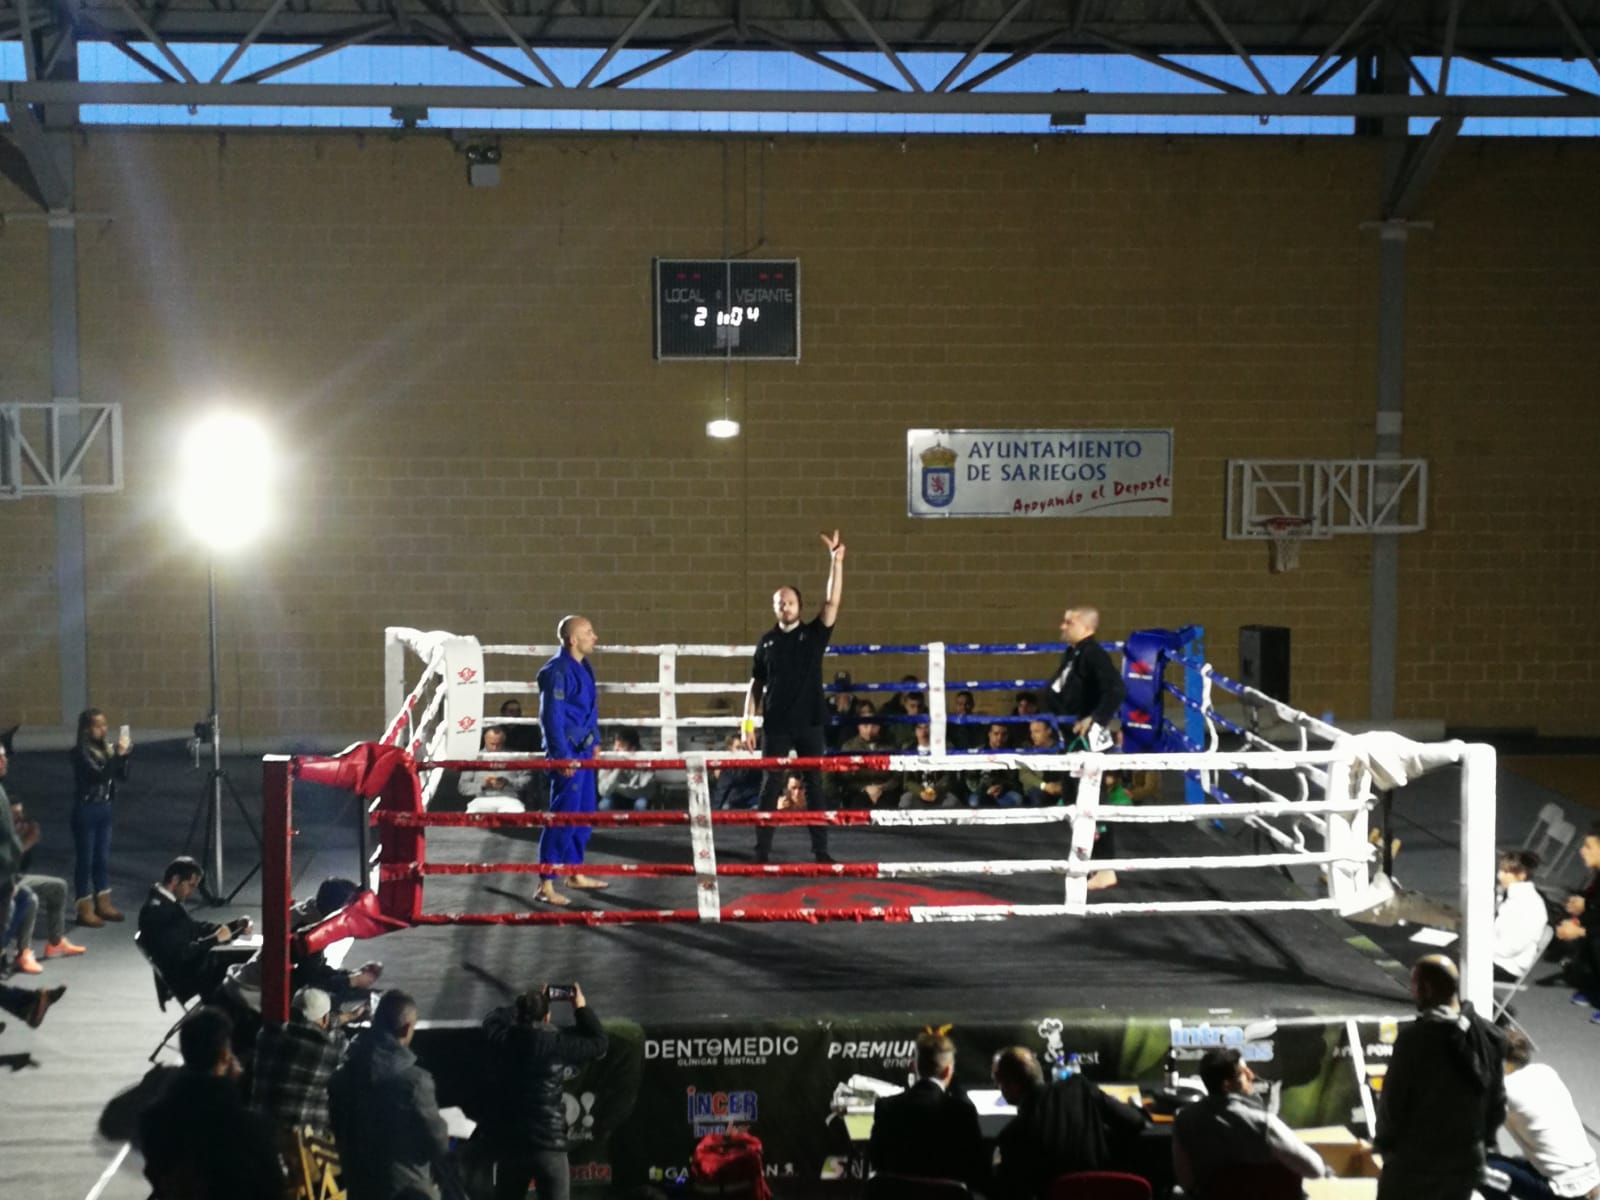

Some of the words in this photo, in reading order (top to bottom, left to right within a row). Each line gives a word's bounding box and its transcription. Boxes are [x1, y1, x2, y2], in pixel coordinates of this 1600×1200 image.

[665, 288, 705, 303] LOCAL
[736, 288, 793, 303] VISITANTE
[968, 440, 1142, 459] AYUNTAMIENTO
[967, 464, 990, 481] DE
[1001, 463, 1107, 481] SARIEGOS
[1012, 489, 1083, 514] Apoyando
[1092, 484, 1106, 500] el
[1114, 474, 1171, 497] Deporte
[645, 1036, 799, 1059] DENTOMEDIC
